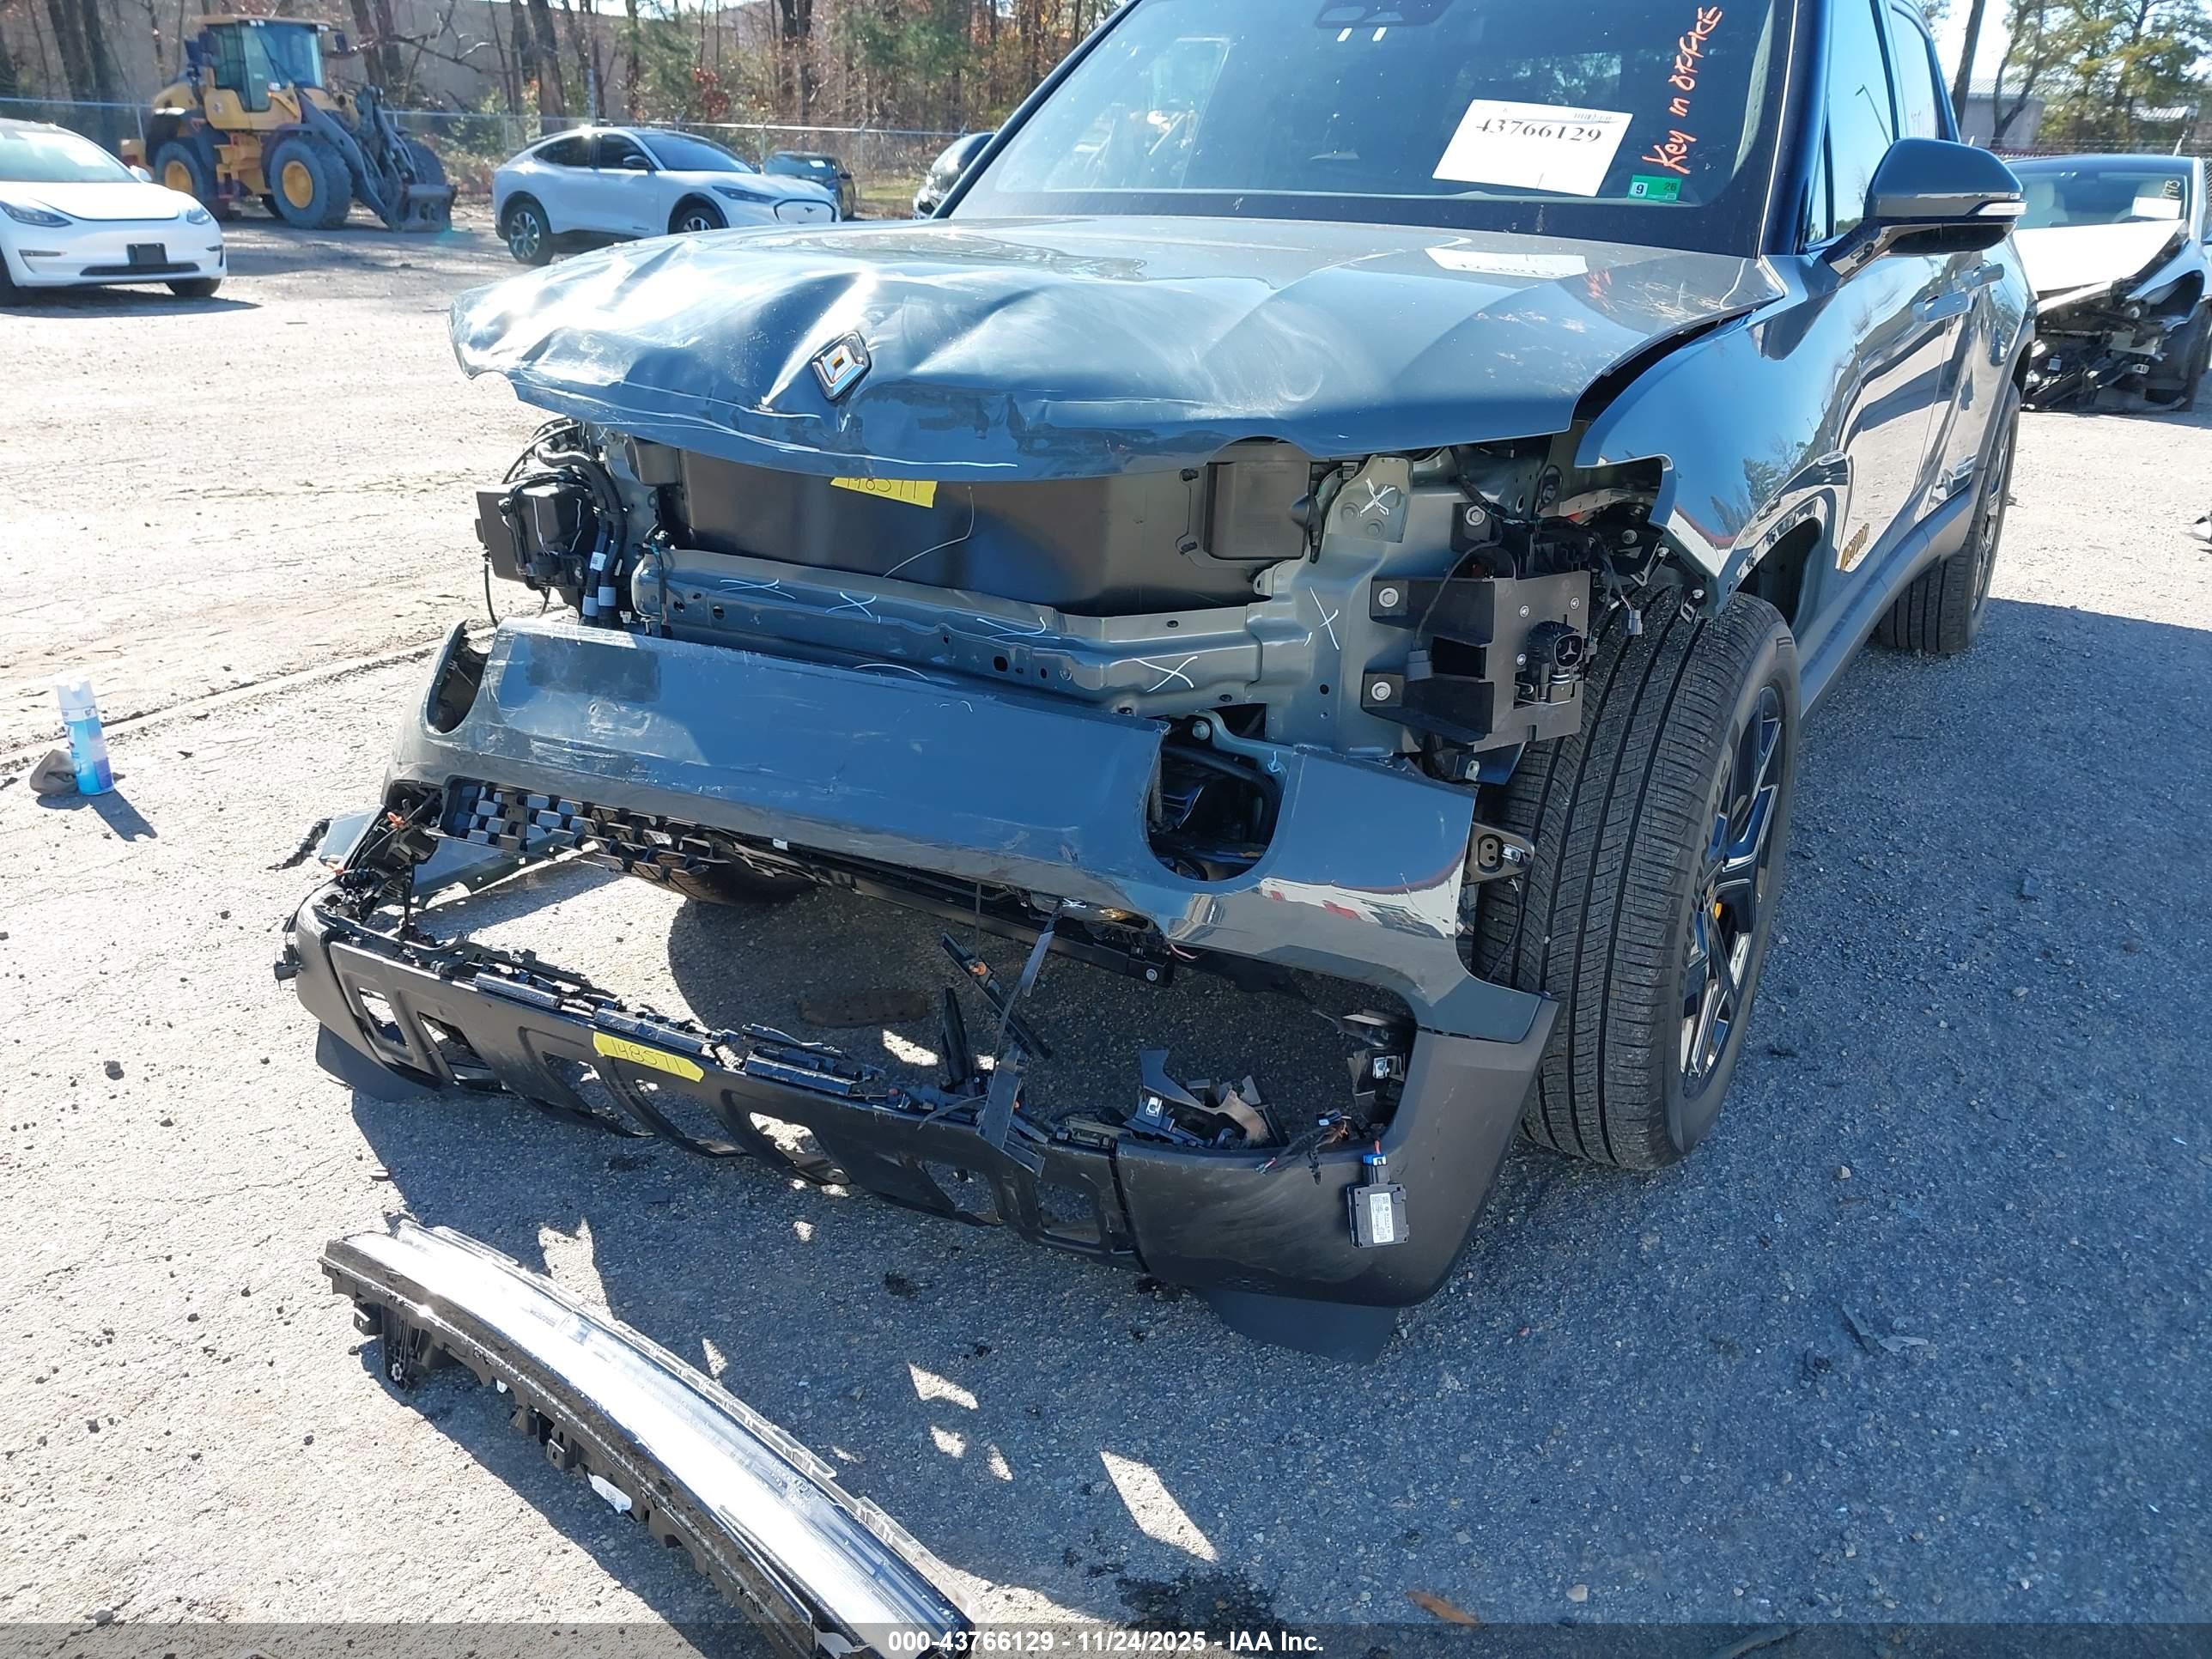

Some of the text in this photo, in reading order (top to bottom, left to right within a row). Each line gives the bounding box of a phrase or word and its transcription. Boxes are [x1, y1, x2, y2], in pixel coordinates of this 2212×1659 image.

[1476, 118, 1602, 143] 43766129
[1641, 130, 1697, 174] Key
[1635, 183, 1644, 195] 9
[611, 1038, 682, 1073] 148571
